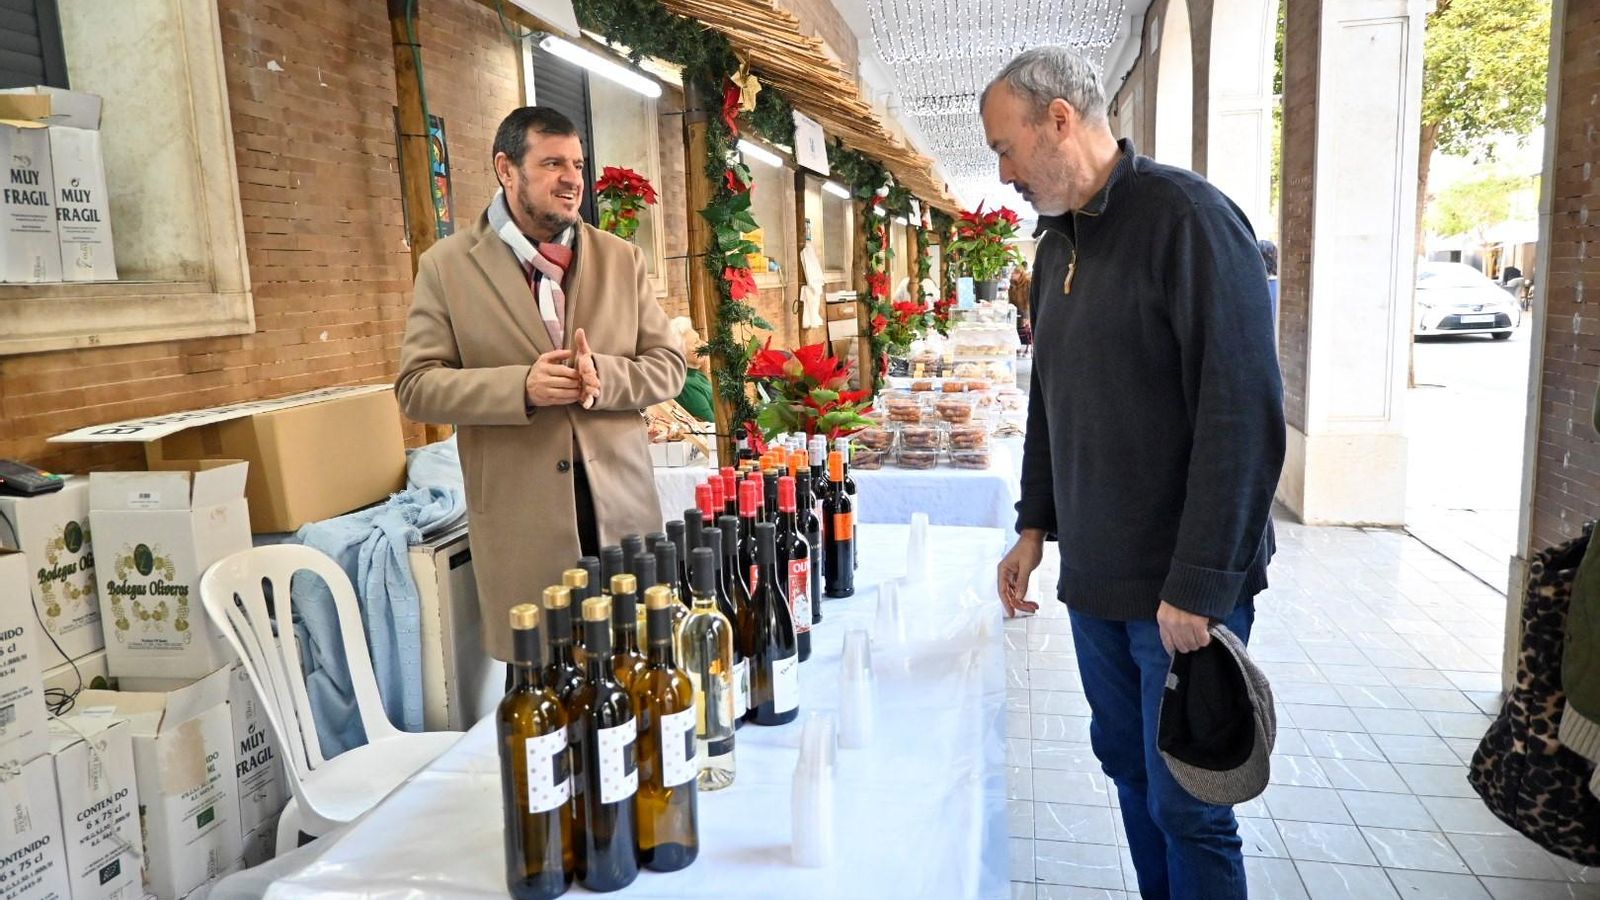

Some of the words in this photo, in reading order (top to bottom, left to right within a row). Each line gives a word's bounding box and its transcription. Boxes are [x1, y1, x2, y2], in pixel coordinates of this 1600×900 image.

[10, 168, 39, 185] MUY
[4, 189, 50, 206] FRAGIL
[61, 188, 91, 203] MUY
[56, 207, 101, 222] FRAGIL
[37, 562, 77, 584] Bodegas
[107, 579, 147, 600] Bodegas
[149, 579, 189, 596] Oliveros
[241, 729, 265, 755] MUY
[236, 746, 274, 778] FRAGIL
[77, 788, 128, 822] CONTENDO
[86, 821, 92, 829] 6
[102, 811, 112, 821] 75
[19, 859, 31, 872] 75
[34, 852, 43, 863] cl
